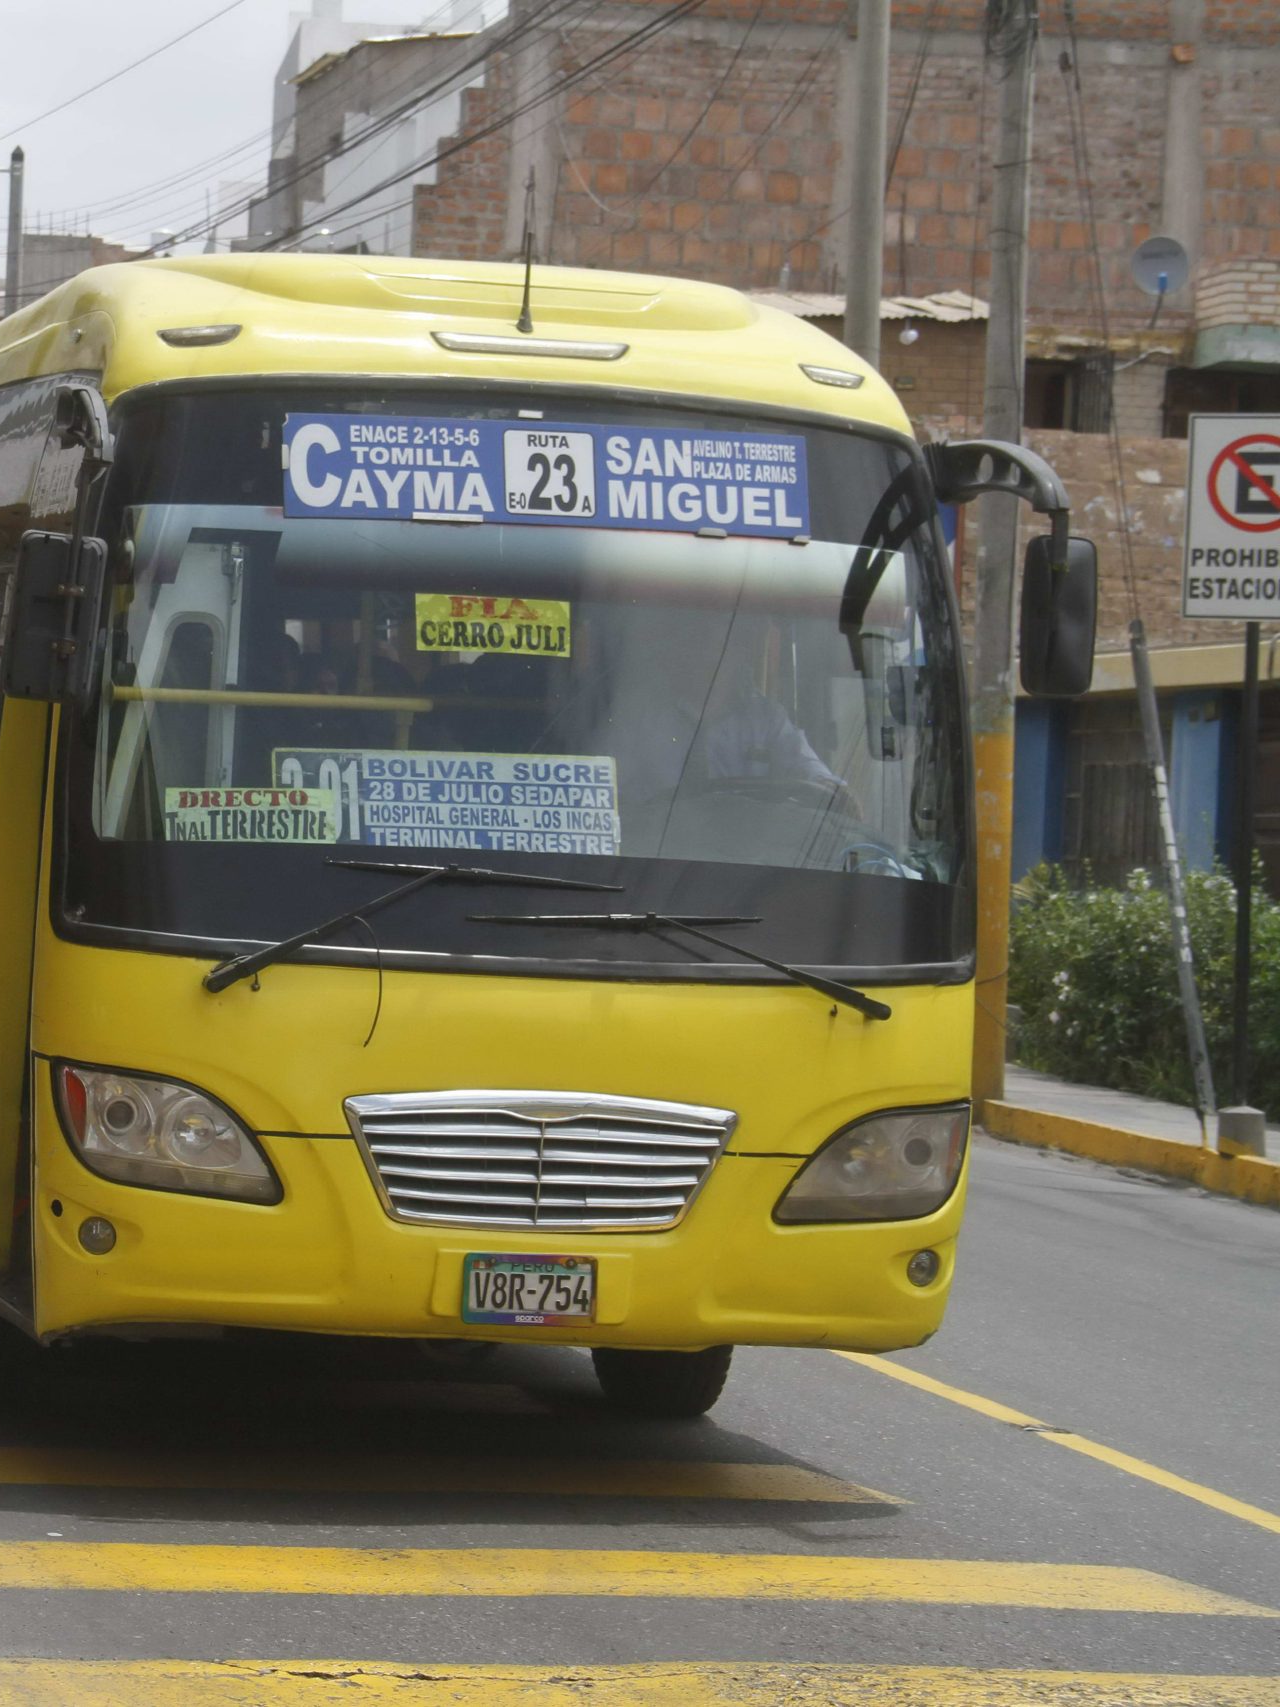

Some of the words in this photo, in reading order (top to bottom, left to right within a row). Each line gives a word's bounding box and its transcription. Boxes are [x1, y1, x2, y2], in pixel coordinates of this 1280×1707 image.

[350, 425, 408, 444] ENACE
[413, 427, 480, 446] 2-13-5-6
[527, 434, 569, 449] RUTA
[350, 446, 480, 468] TOMILLA
[606, 435, 693, 479] SAN
[693, 440, 733, 459] AVELINO
[734, 441, 743, 459] T.
[744, 442, 797, 463] TERRESTRE
[289, 423, 495, 513] CAYMA
[693, 461, 733, 480] PLAZA
[735, 463, 752, 481] DE
[754, 464, 798, 484] ARMAS
[608, 479, 803, 528] MIGUEL
[1189, 578, 1280, 600] ESTACIO
[448, 596, 539, 620] FIA
[421, 621, 505, 648] CERRO
[510, 624, 567, 652] JULI
[367, 758, 495, 781] BOLIVAR
[513, 762, 611, 784] SUCRE
[369, 781, 395, 800] 28
[402, 782, 431, 801] DE
[438, 782, 504, 803] JULIO
[510, 785, 612, 808] SEDAPAR
[370, 805, 445, 825] HOSPITAL
[448, 807, 519, 827] GENERAL
[533, 809, 561, 829] LOS
[567, 811, 612, 832] INCAS
[370, 828, 483, 850] TERMINAL
[488, 831, 614, 855] TERRESTRE
[474, 1271, 589, 1313] V8R-754
